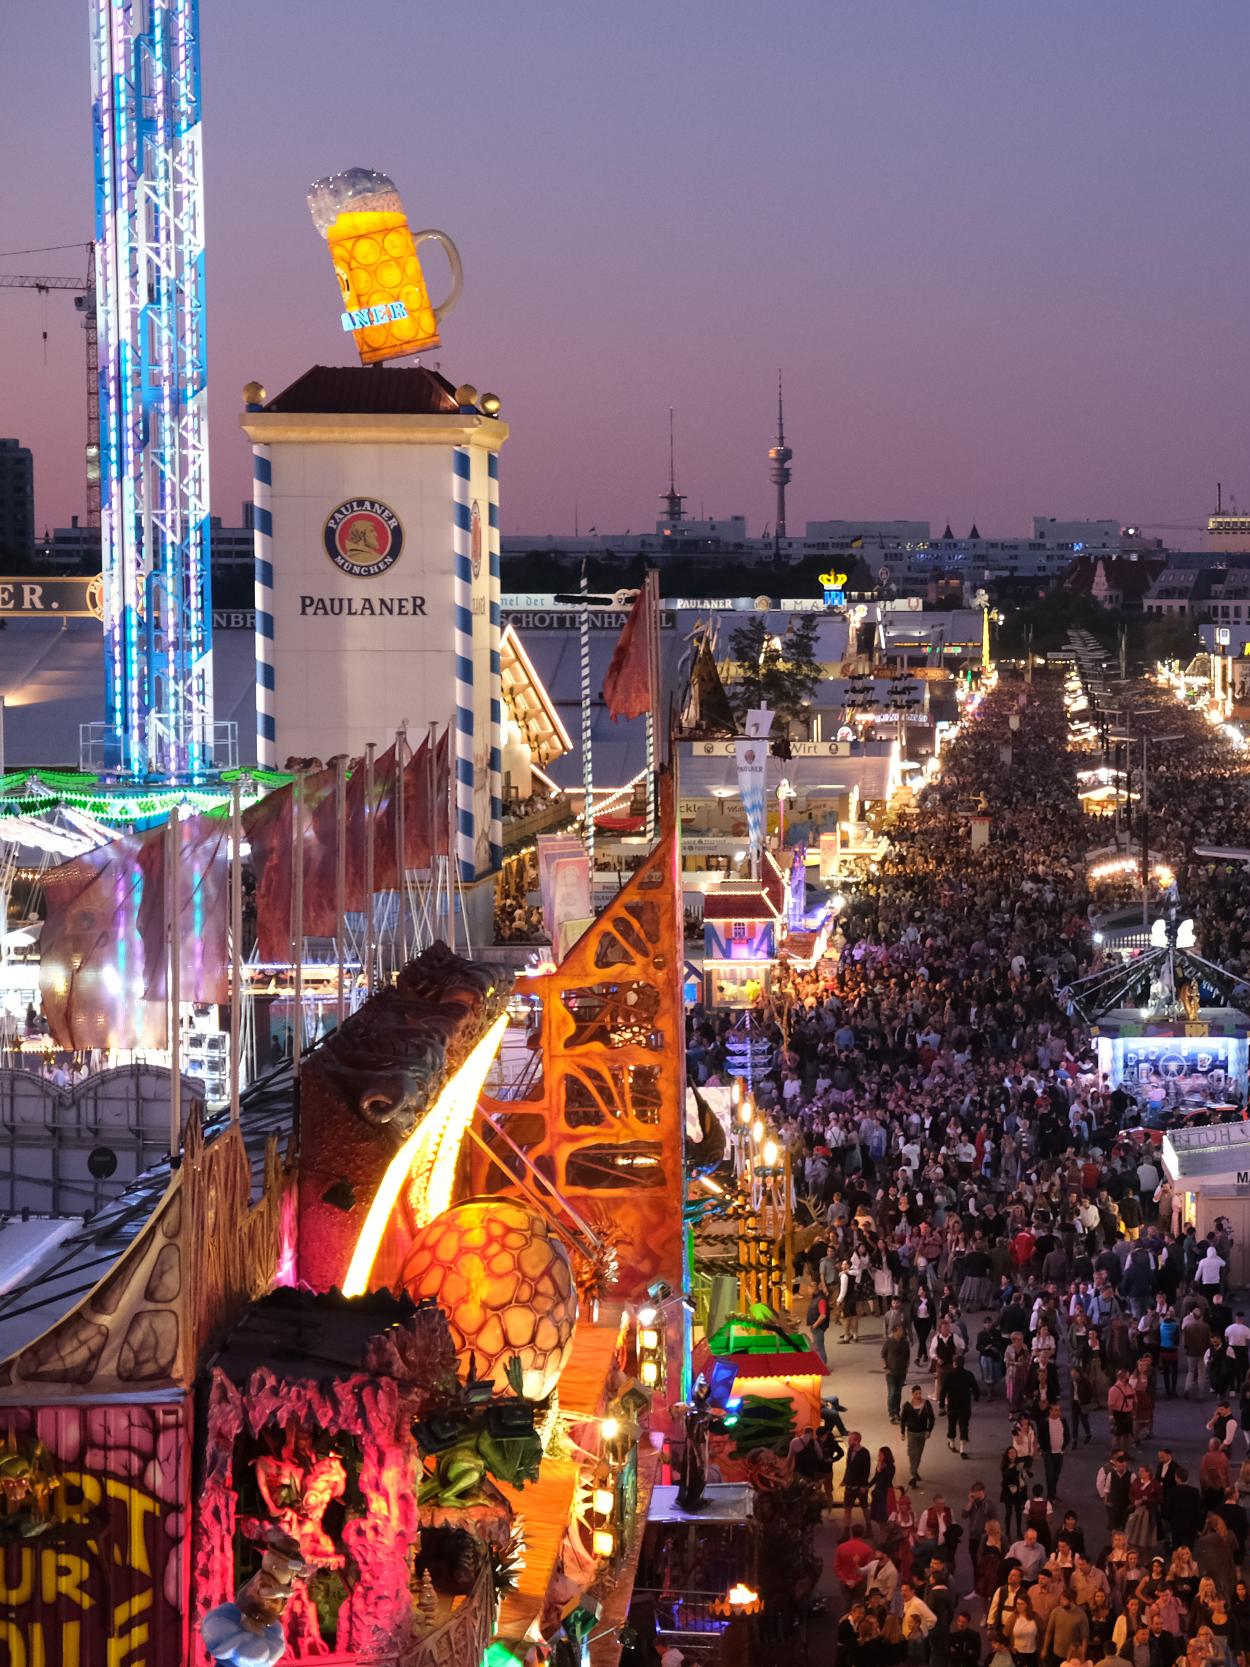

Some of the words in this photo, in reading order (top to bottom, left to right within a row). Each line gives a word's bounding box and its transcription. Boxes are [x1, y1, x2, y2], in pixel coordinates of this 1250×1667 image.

[327, 500, 399, 529] PAULANER
[334, 554, 394, 576] MÜNCHEN
[299, 595, 428, 616] PAULANER
[676, 598, 733, 609] PAULANER
